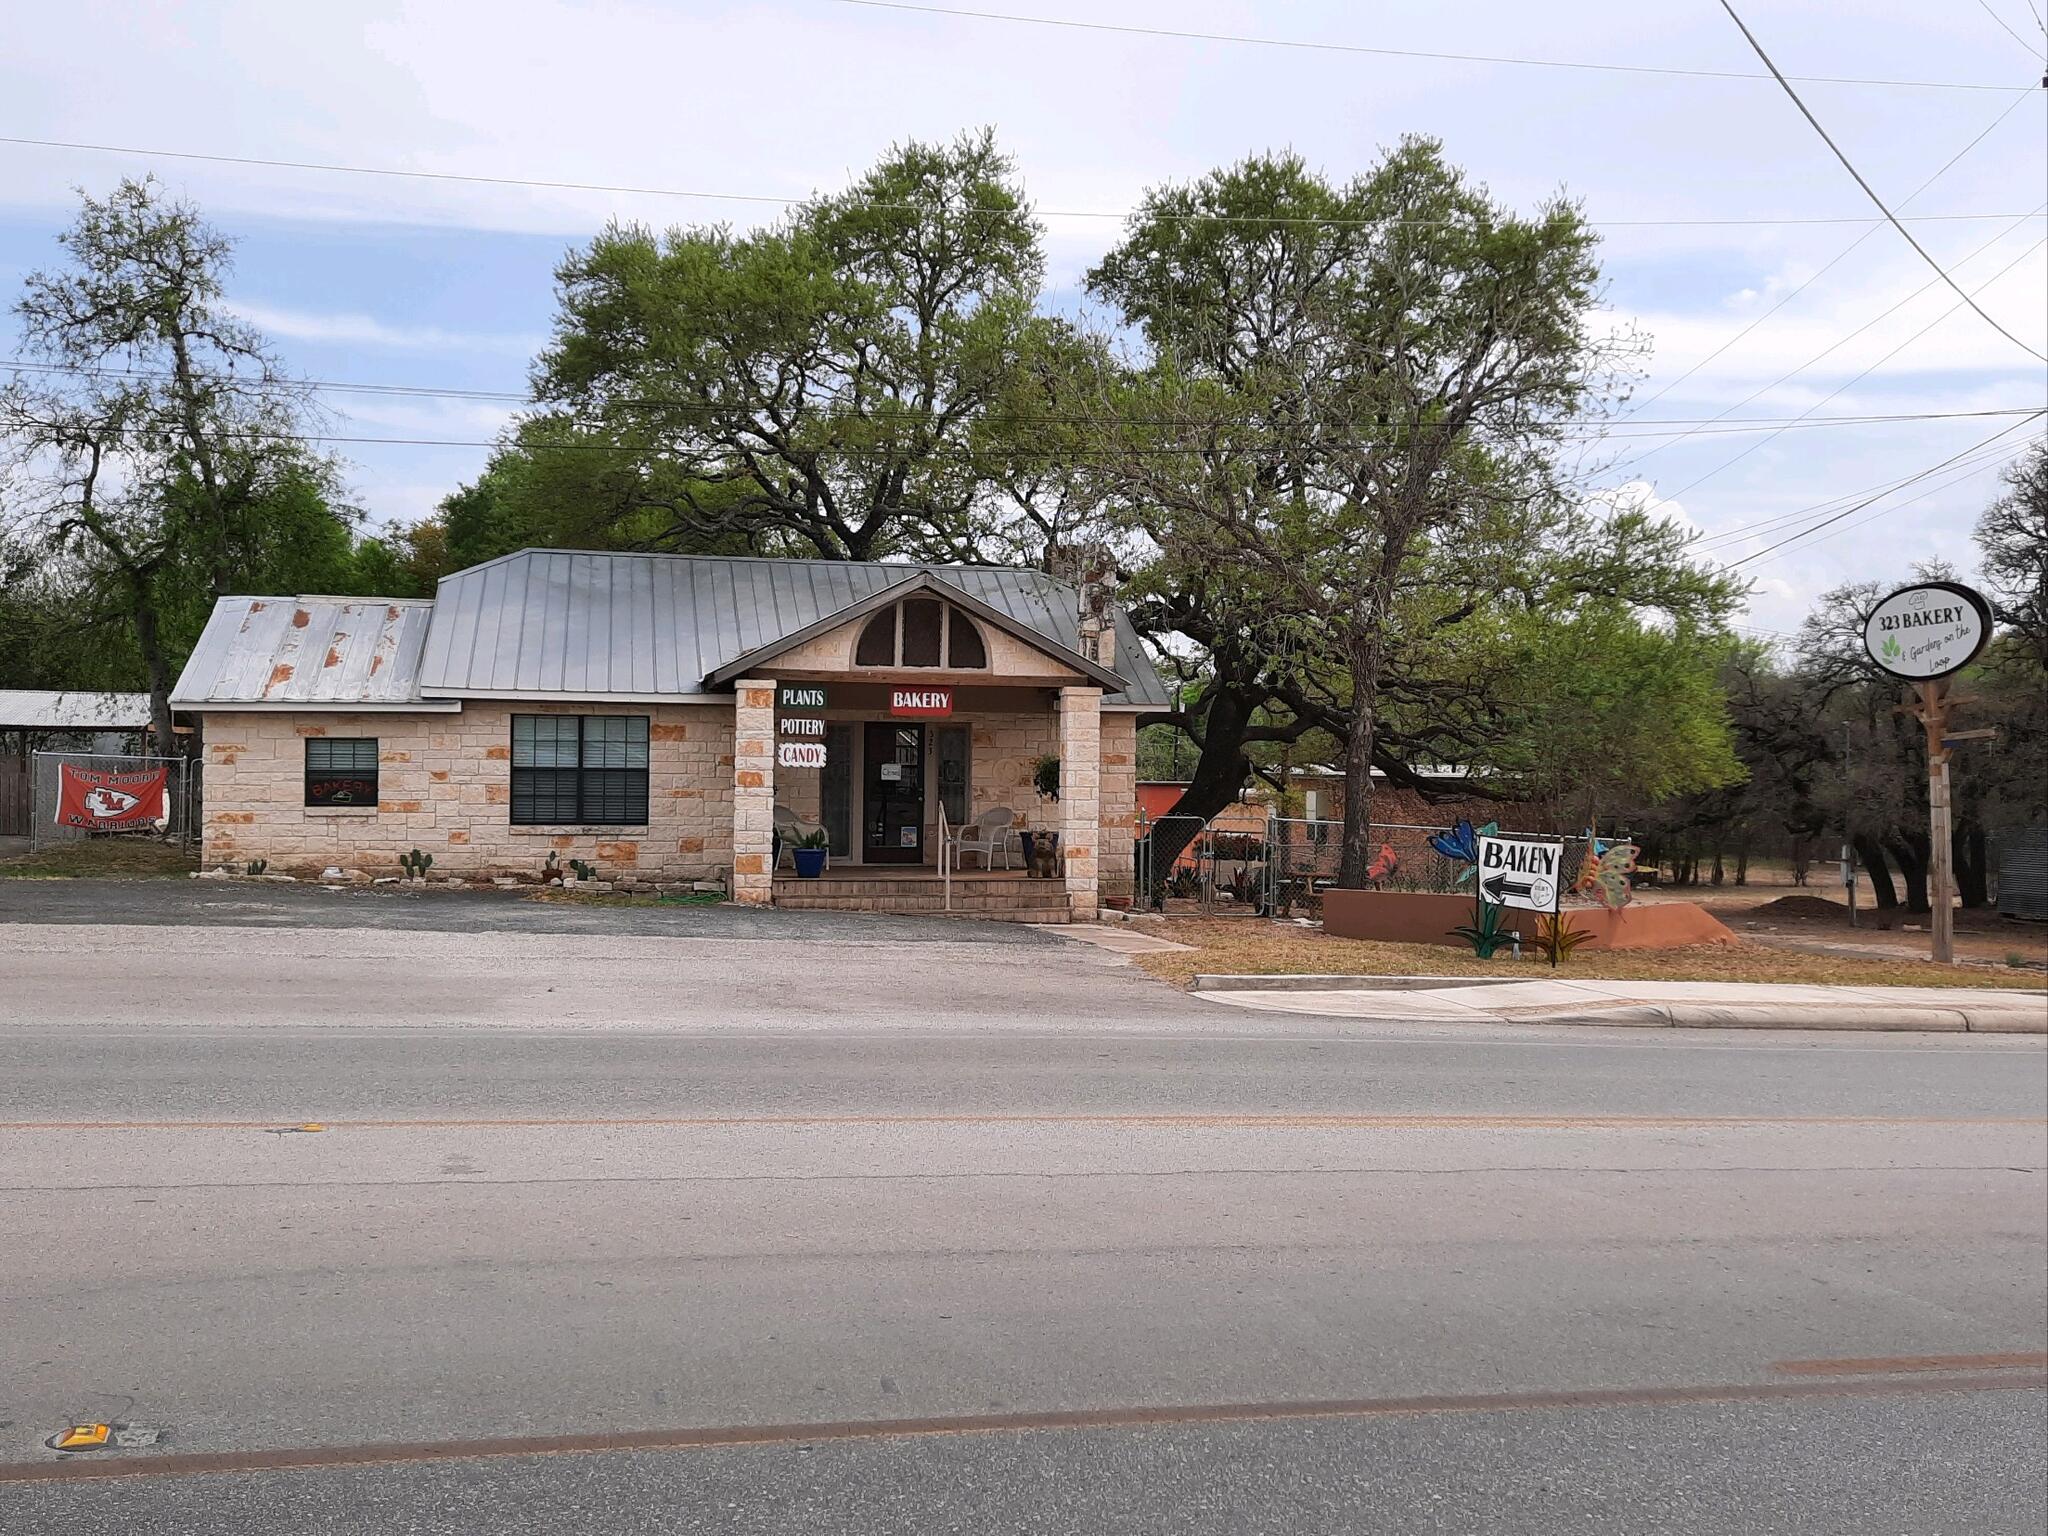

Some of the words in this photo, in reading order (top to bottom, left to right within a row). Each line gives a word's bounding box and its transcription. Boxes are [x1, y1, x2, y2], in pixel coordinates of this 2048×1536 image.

[1879, 615, 1900, 631] 323
[1903, 606, 1964, 628] BAKERY
[1944, 634, 1954, 643] on
[1956, 624, 1971, 640] the
[1929, 657, 1950, 673] Loop
[782, 689, 824, 706] PLANTS
[893, 692, 950, 708] BAKERY
[781, 719, 825, 735] POTTERY
[783, 747, 822, 763] CANDY
[70, 769, 101, 783] TOM
[1484, 842, 1556, 875] BAKERY
